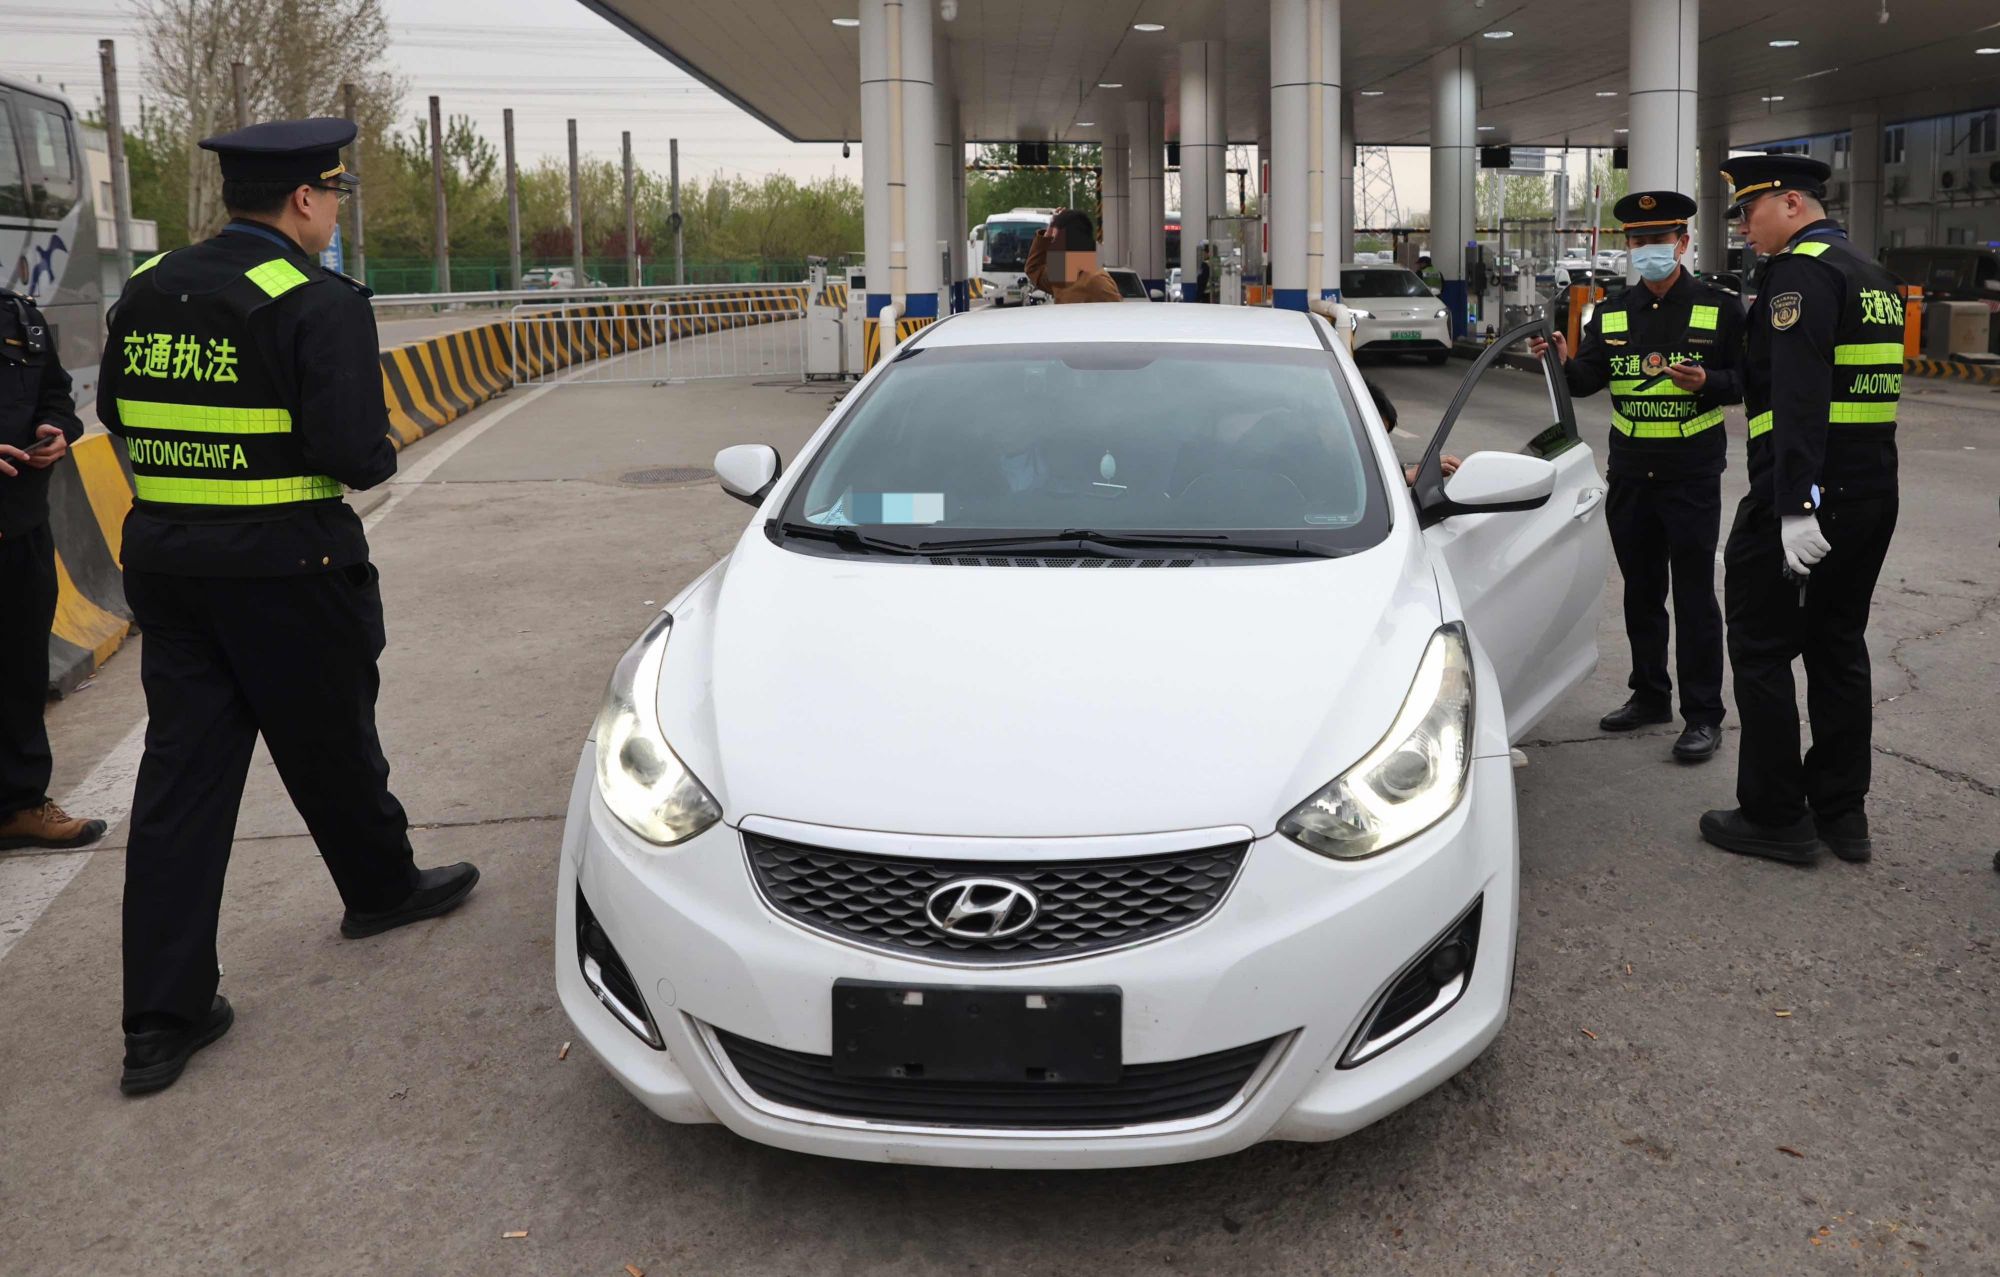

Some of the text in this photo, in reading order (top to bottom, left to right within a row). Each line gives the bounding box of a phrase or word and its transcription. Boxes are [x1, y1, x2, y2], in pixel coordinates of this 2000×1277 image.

[1860, 287, 1904, 326] 交通执法
[123, 330, 239, 383] 交通执法
